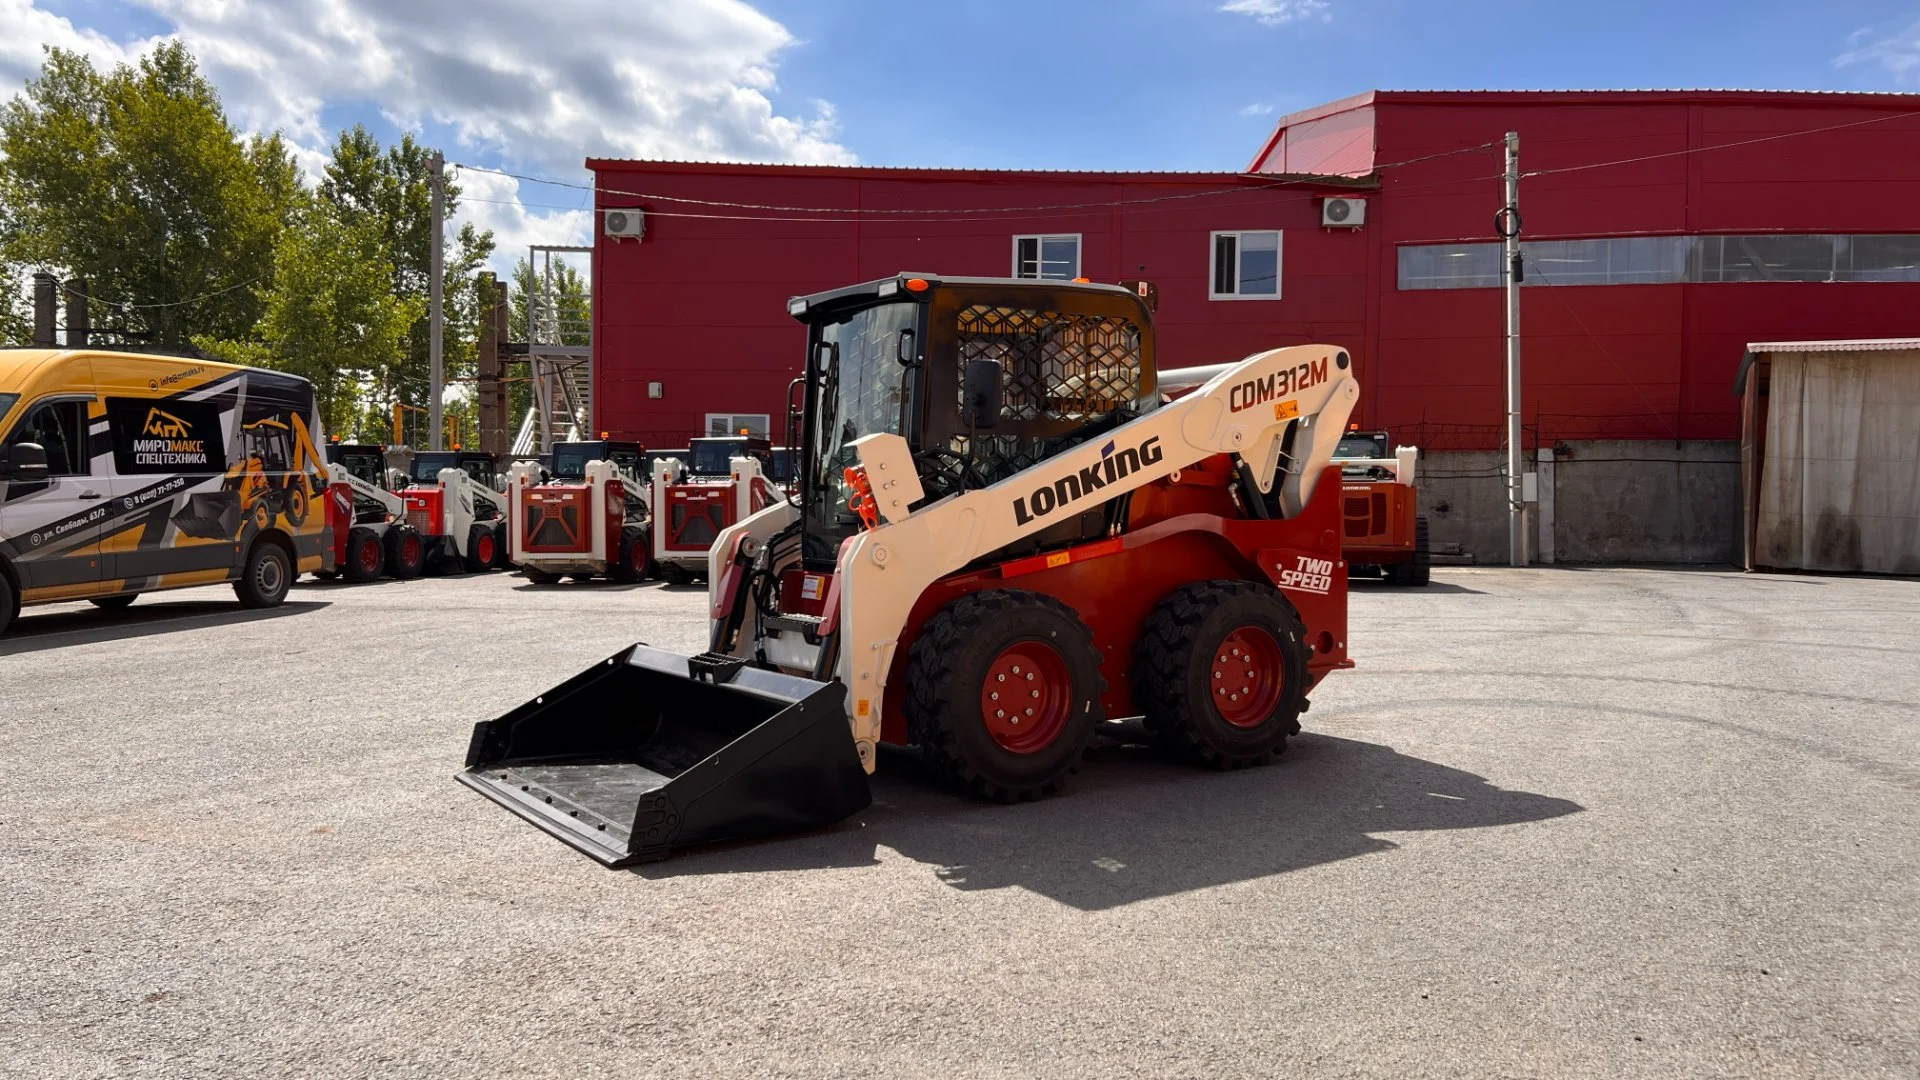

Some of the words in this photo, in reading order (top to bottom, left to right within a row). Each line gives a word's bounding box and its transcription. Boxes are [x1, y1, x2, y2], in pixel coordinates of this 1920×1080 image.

[1230, 356, 1328, 413] CDM312M
[133, 439, 204, 453] МИРОМАКС
[136, 453, 207, 466] СПЕЦТЕХНИКА
[1012, 435, 1163, 527] LONKING
[133, 495, 140, 504] 8
[1297, 555, 1333, 576] TWO
[1279, 569, 1332, 591] SPEED
